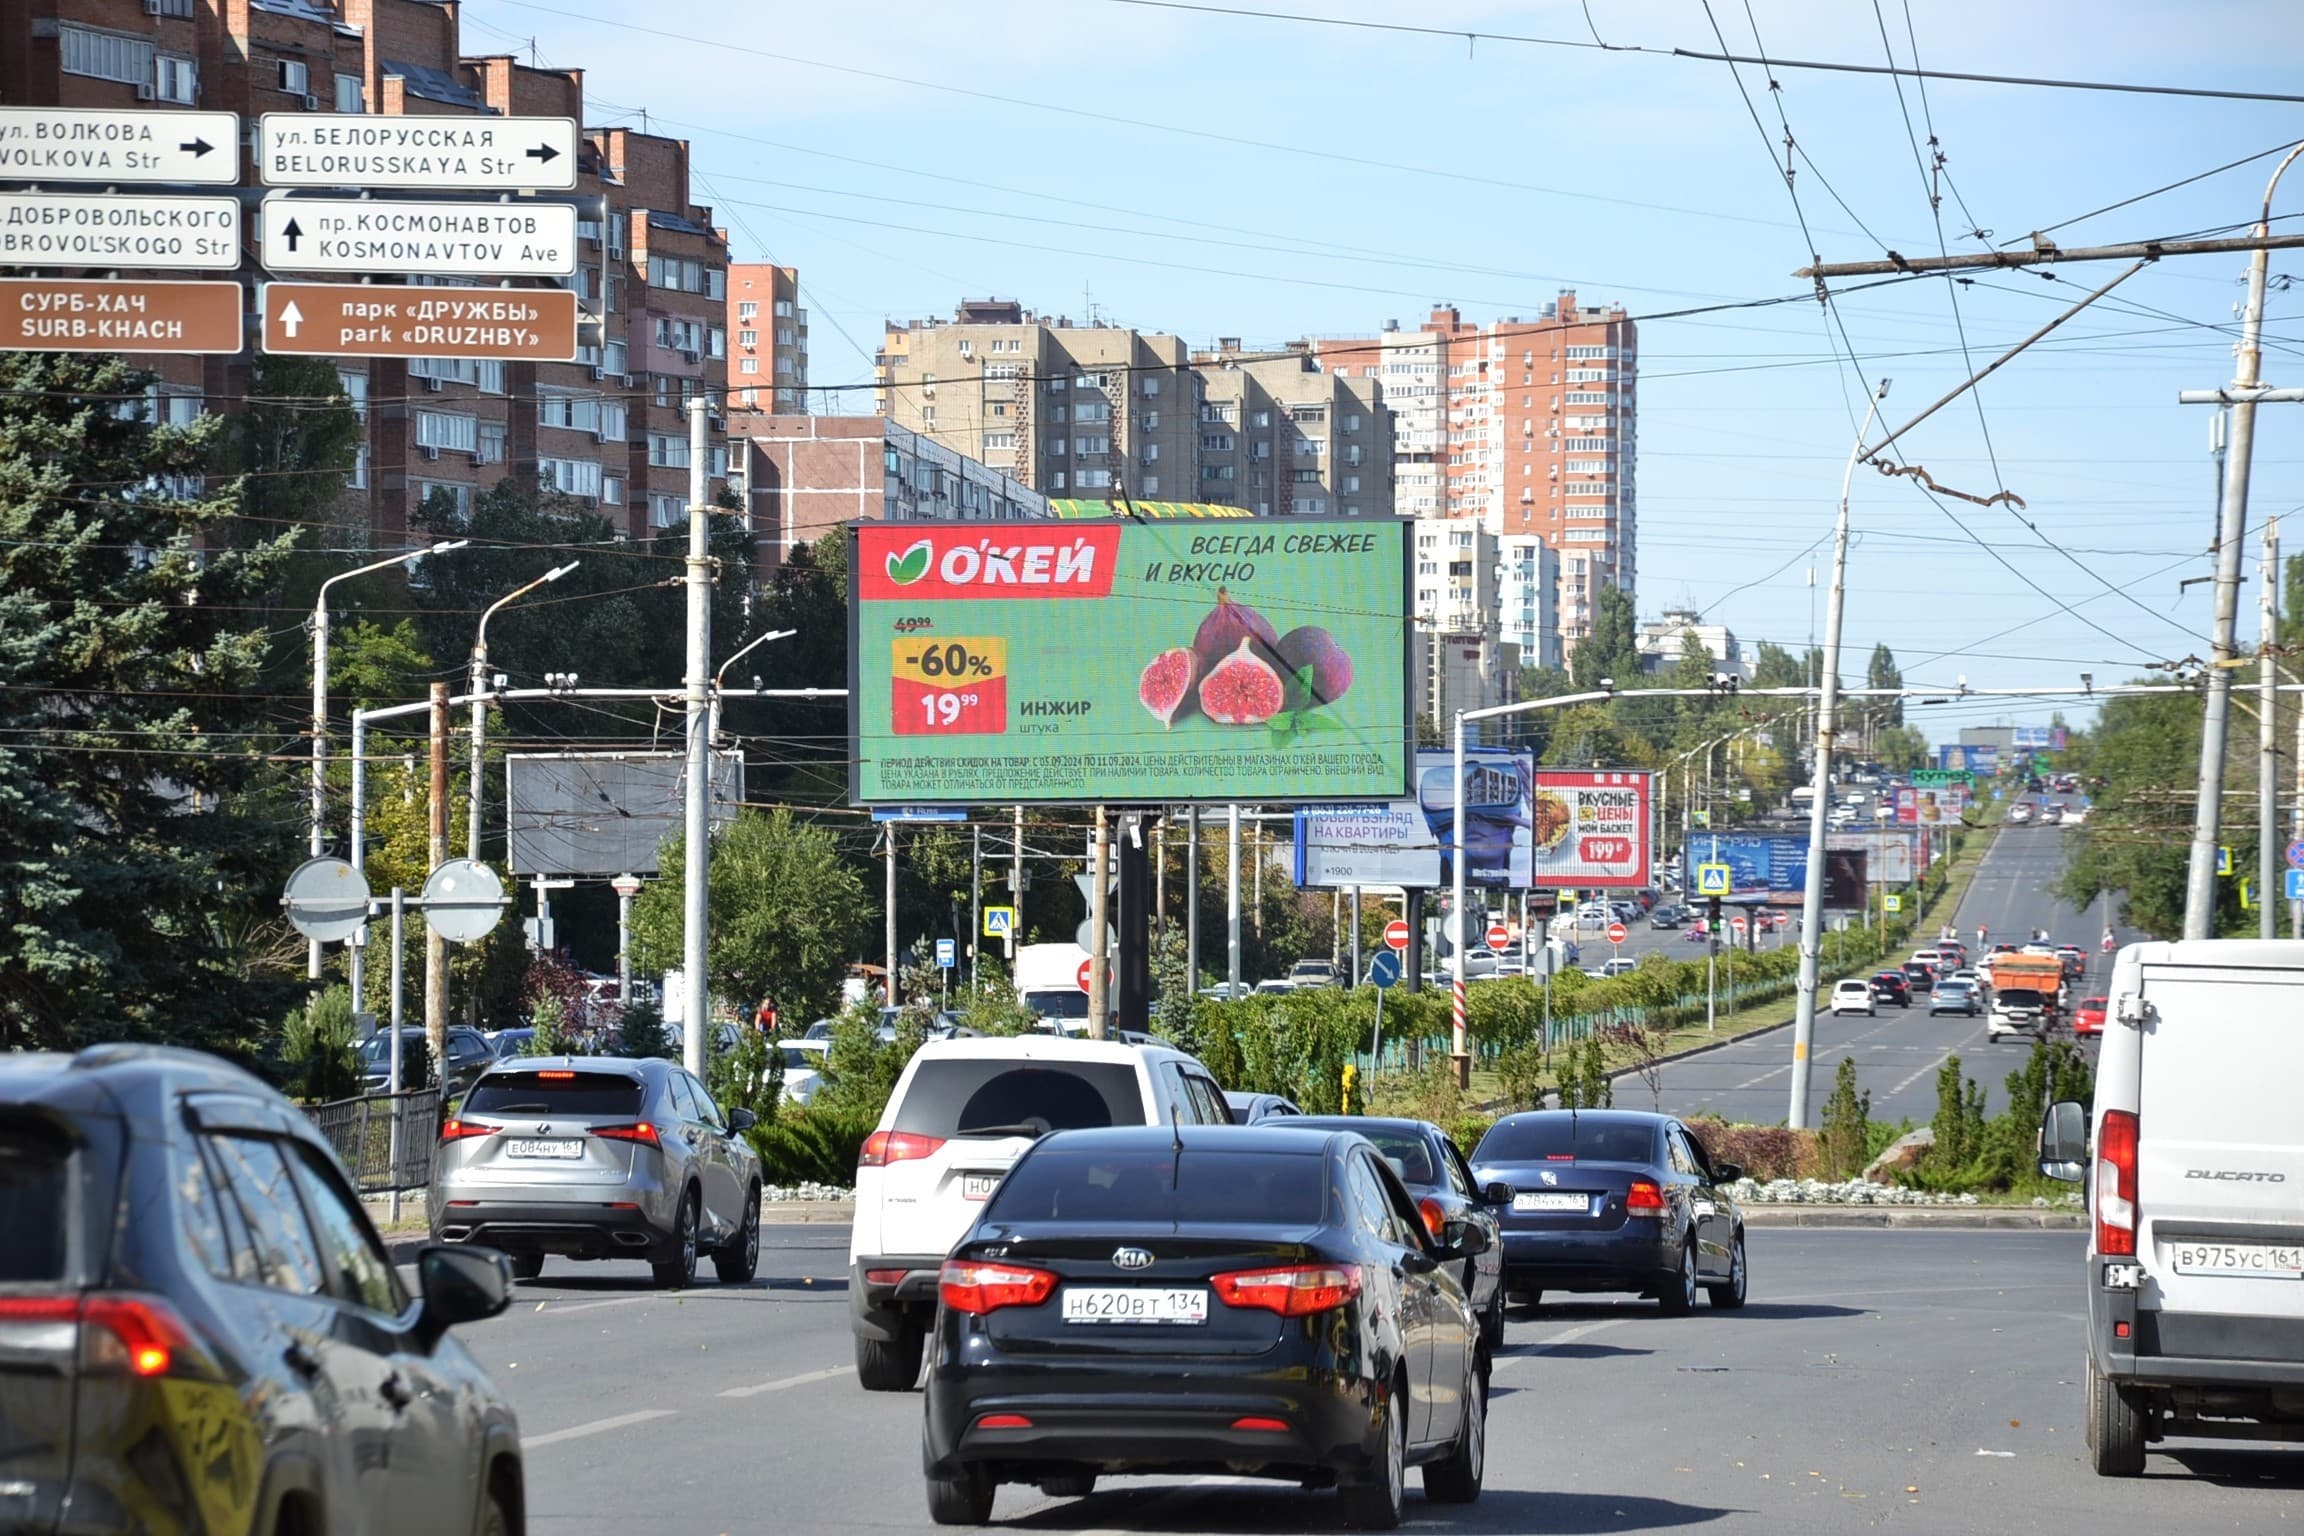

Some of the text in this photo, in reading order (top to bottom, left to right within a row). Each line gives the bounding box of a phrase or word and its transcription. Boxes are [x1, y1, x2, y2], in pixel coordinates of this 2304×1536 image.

[36, 122, 153, 142] ВОЛКОВА
[314, 128, 494, 148] БЕЛОРУССКАЯ
[0, 149, 161, 169] VOLKOVA Str
[275, 155, 516, 175] BELORUSSKAYA Str
[7, 206, 232, 228] ДОБРОВОЛЬСКОГО
[357, 213, 537, 234] КОСМОНАВТОВ
[0, 233, 230, 255] BROVOL'SKOGO Str
[319, 240, 558, 262] KOSMONAVTOV Ave
[20, 292, 146, 313] СУРБ-ХАЧ
[341, 300, 539, 321] парк «ДРУЖБЫ»
[21, 318, 183, 339] SURB-KHACH
[340, 325, 540, 347] park «DRUZHBY»
[1190, 534, 1378, 556] ВСЕГДА СВЕЖЕЕ
[1145, 561, 1255, 582] И ВКУСНО
[906, 643, 993, 677] -60%
[1020, 701, 1092, 716] ИНЖИР
[1019, 722, 1059, 736] штука
[881, 757, 912, 768] ПЕРИОД
[914, 755, 955, 768] ДЕЙСТВИЯ
[957, 757, 989, 768] СКИДОК
[991, 757, 1002, 767] НА
[1085, 756, 1096, 766] ПО
[1144, 755, 1166, 766] ЦЕНЫ
[1168, 753, 1235, 766] ДЕЙСТВИТЕЛЬНЫ
[1245, 754, 1291, 765] МАГАЗИНАХ
[1318, 753, 1350, 764] ВАШЕГО
[881, 769, 900, 779] ЦЕНА
[903, 769, 939, 779] УКАЗАНА
[983, 768, 1040, 778] ПРЕДЛОЖЕНИЕ
[1043, 766, 1088, 778] ДЕЙСТВУЕТ
[1090, 767, 1106, 777] ПРИ
[1108, 767, 1147, 777] НАЛИЧИИ
[1183, 766, 1234, 776] КОЛИЧЕСТВО
[1237, 766, 1267, 776] ТОВАРА
[1325, 764, 1365, 776] ВНЕШНИЙ
[1367, 765, 1384, 775] ВИД
[881, 779, 911, 790] ТОВАРА
[913, 779, 942, 790] МОЖЕТ
[944, 779, 993, 789] ОТЛИЧАТЬСЯ
[995, 779, 1006, 789] ОТ
[1578, 791, 1635, 807] ВКУСНЫЕ
[1597, 807, 1633, 821] ЦЕНЫ
[1314, 826, 1408, 839] НА КВАРТИРЫ
[2184, 1169, 2286, 1183] DUCATO
[2181, 1247, 2302, 1268] В975УС 161
[1070, 1292, 1201, 1315] Н620ВТ 134
